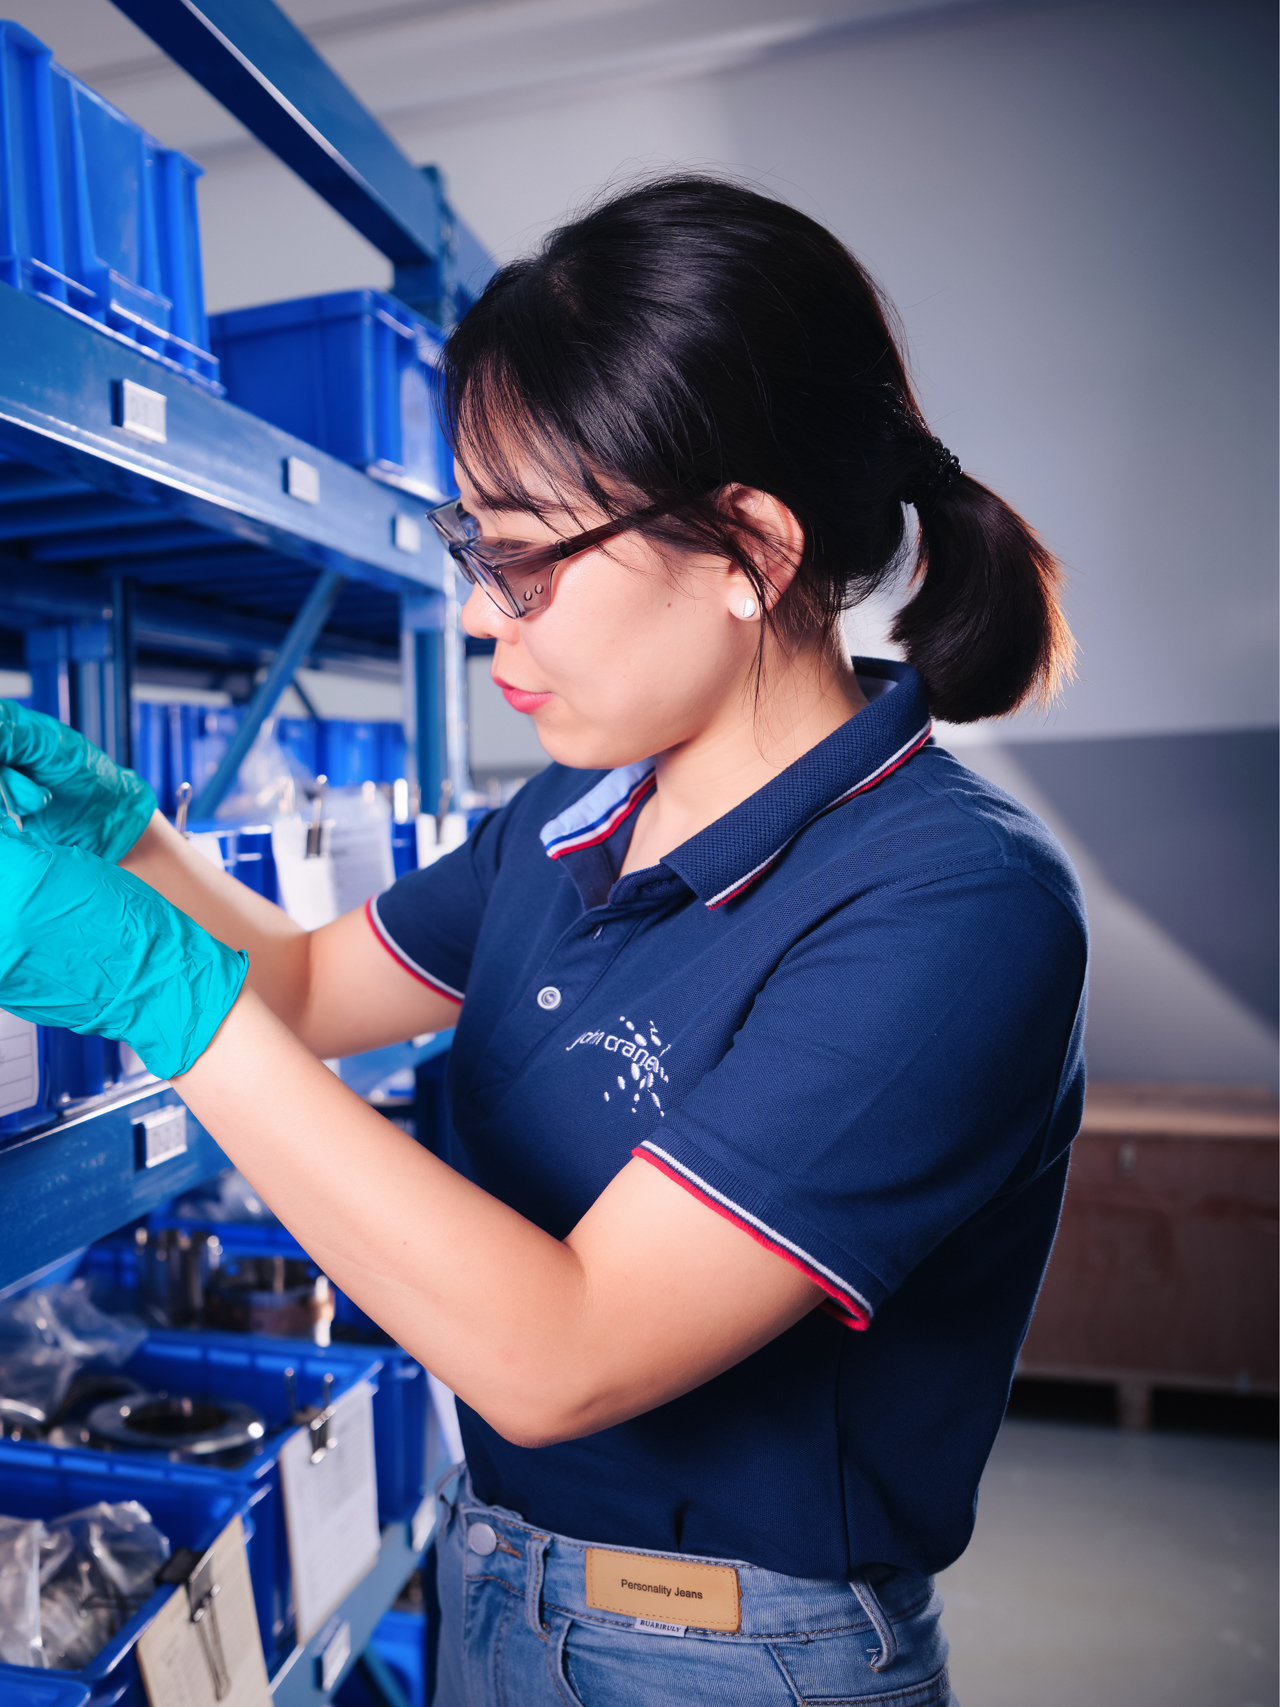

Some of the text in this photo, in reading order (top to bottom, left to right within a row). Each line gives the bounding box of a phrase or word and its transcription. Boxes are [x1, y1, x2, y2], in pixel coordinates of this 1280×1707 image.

[621, 1578, 703, 1599] Personality Jeans
[640, 1619, 682, 1633] BUARIRULY
